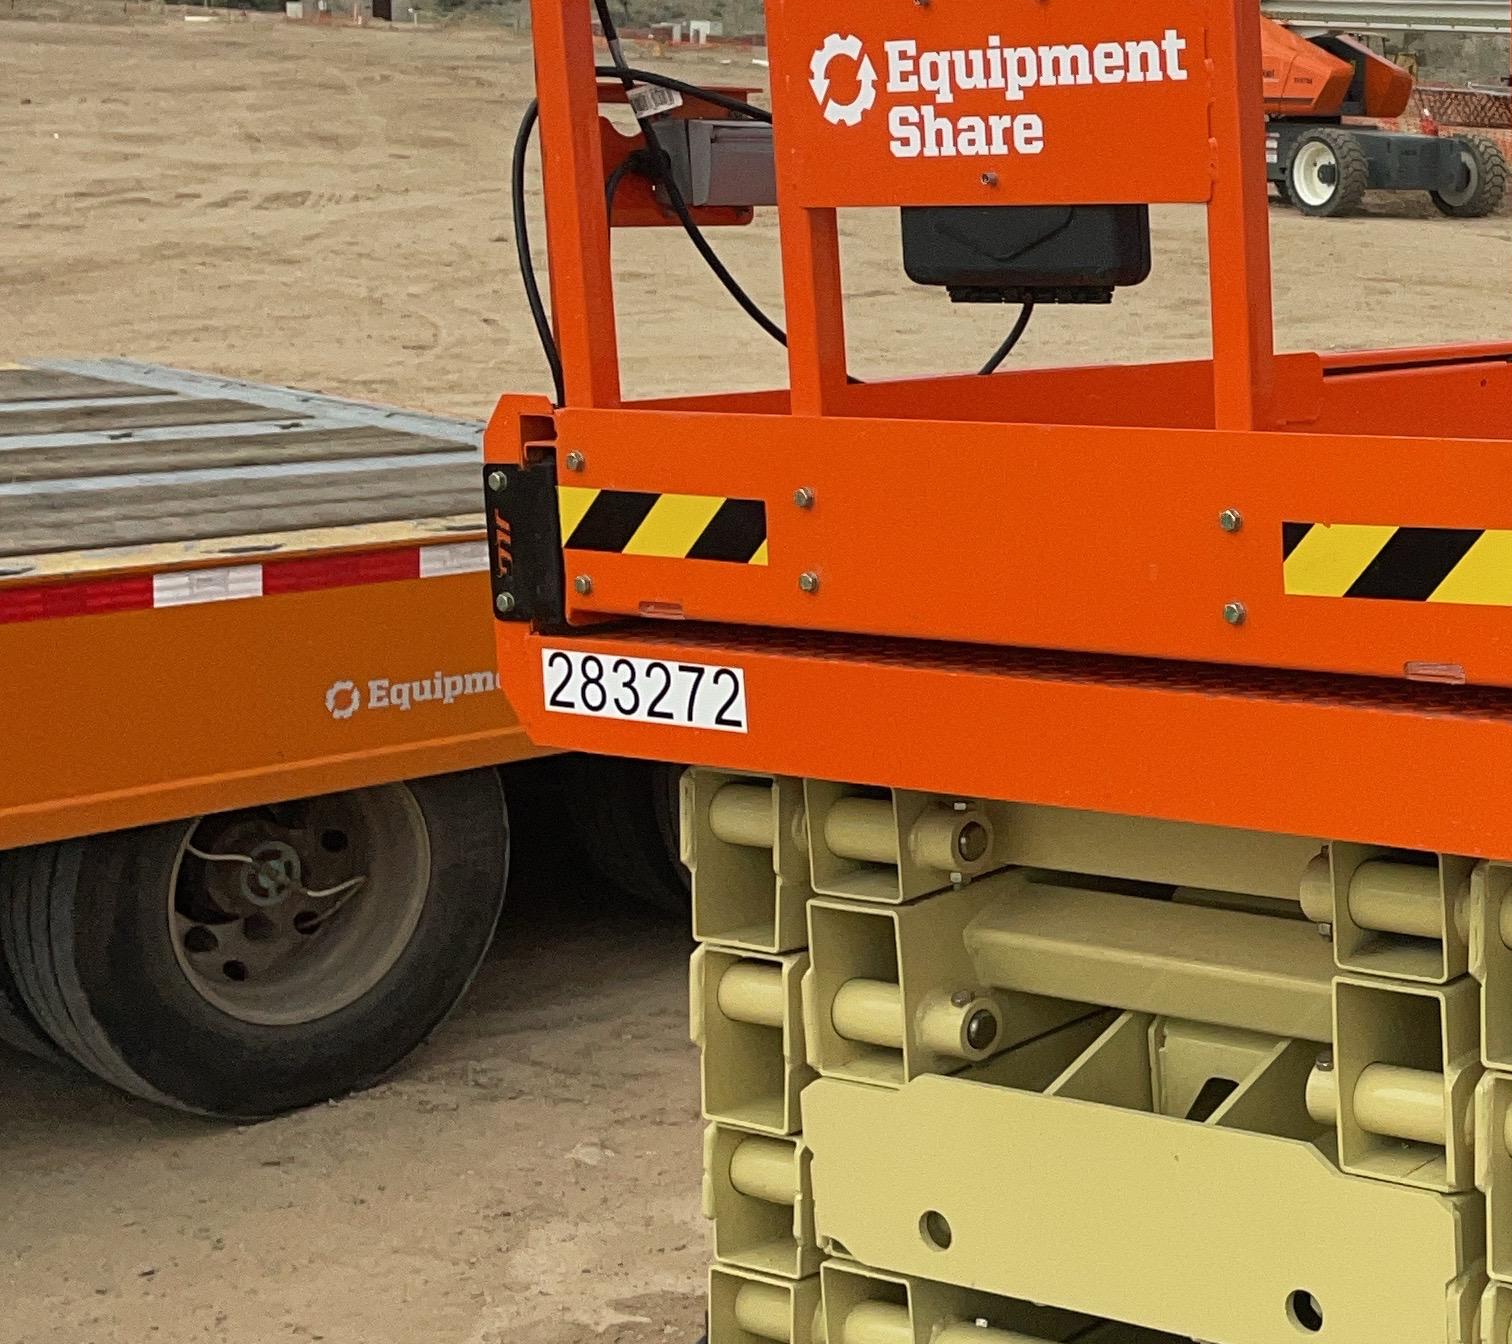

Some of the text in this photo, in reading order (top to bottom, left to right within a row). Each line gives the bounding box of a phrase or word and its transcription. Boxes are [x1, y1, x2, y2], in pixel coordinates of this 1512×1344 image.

[883, 29, 1188, 103] Equipment
[887, 105, 1044, 158] Share
[547, 651, 743, 728] 283272
